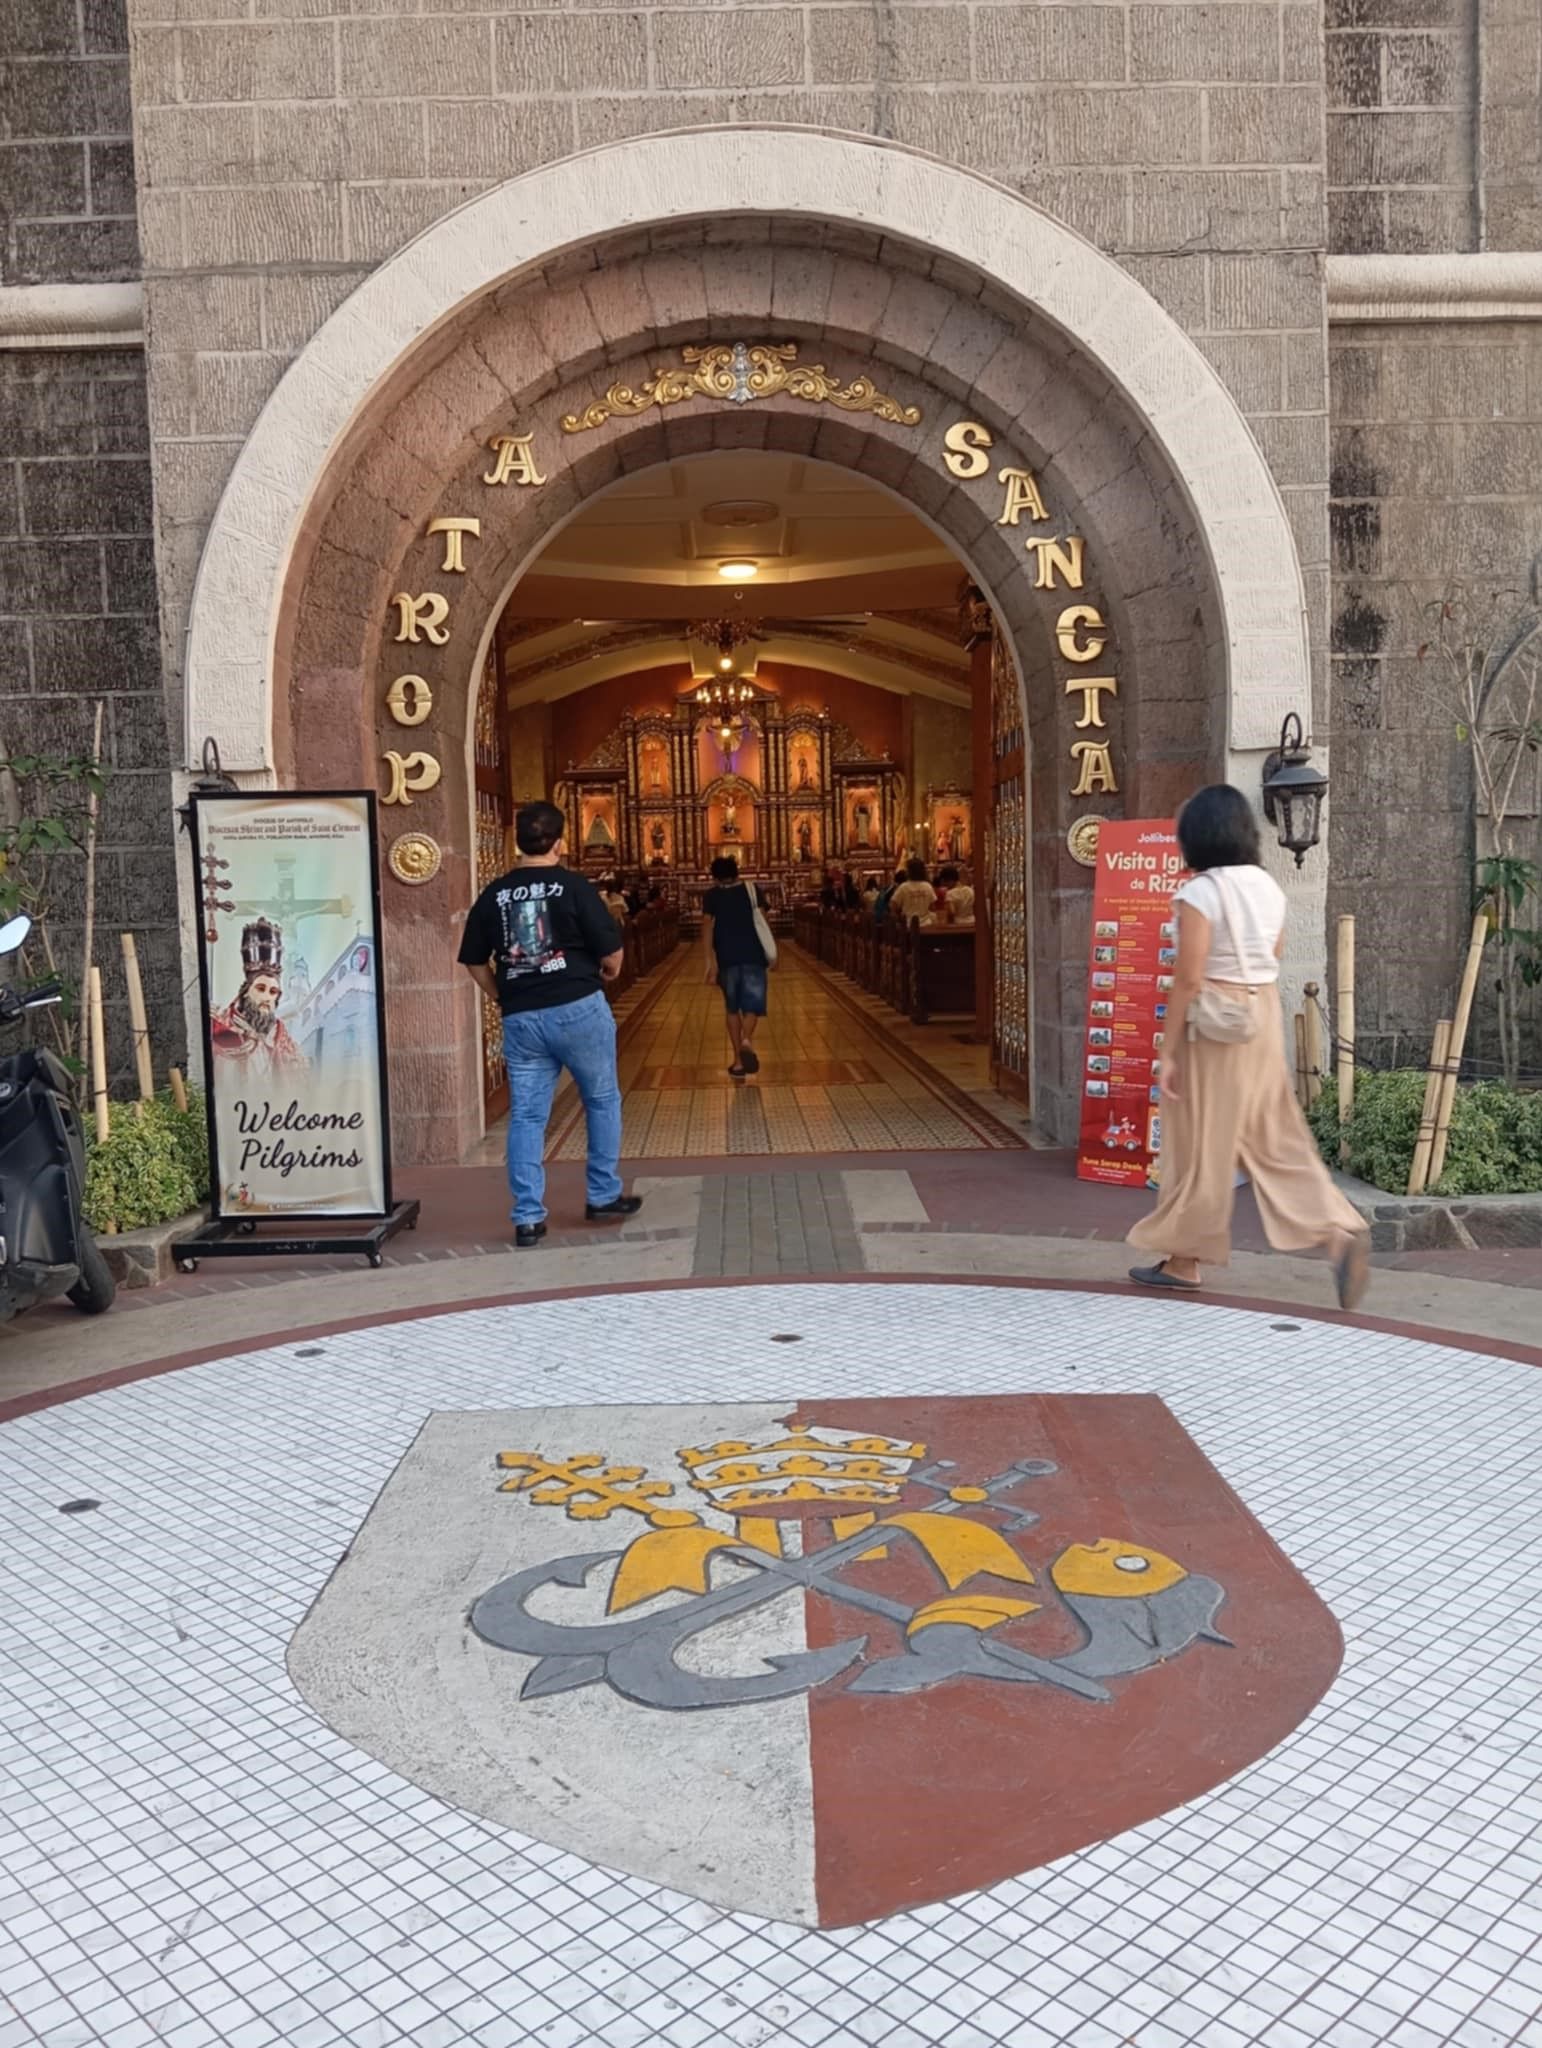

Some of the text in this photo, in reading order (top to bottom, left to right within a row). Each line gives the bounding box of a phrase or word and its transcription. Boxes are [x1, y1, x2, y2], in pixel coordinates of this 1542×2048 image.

[382, 420, 1119, 806] PORTA SANCTA
[264, 825, 277, 833] and
[1105, 851, 1185, 875] Visita Igl
[496, 882, 564, 907] 夜の魅力
[1130, 873, 1188, 893] de Riza
[540, 957, 567, 974] 1988
[234, 1100, 364, 1133] Welcome
[240, 1138, 364, 1178] Pilgrims
